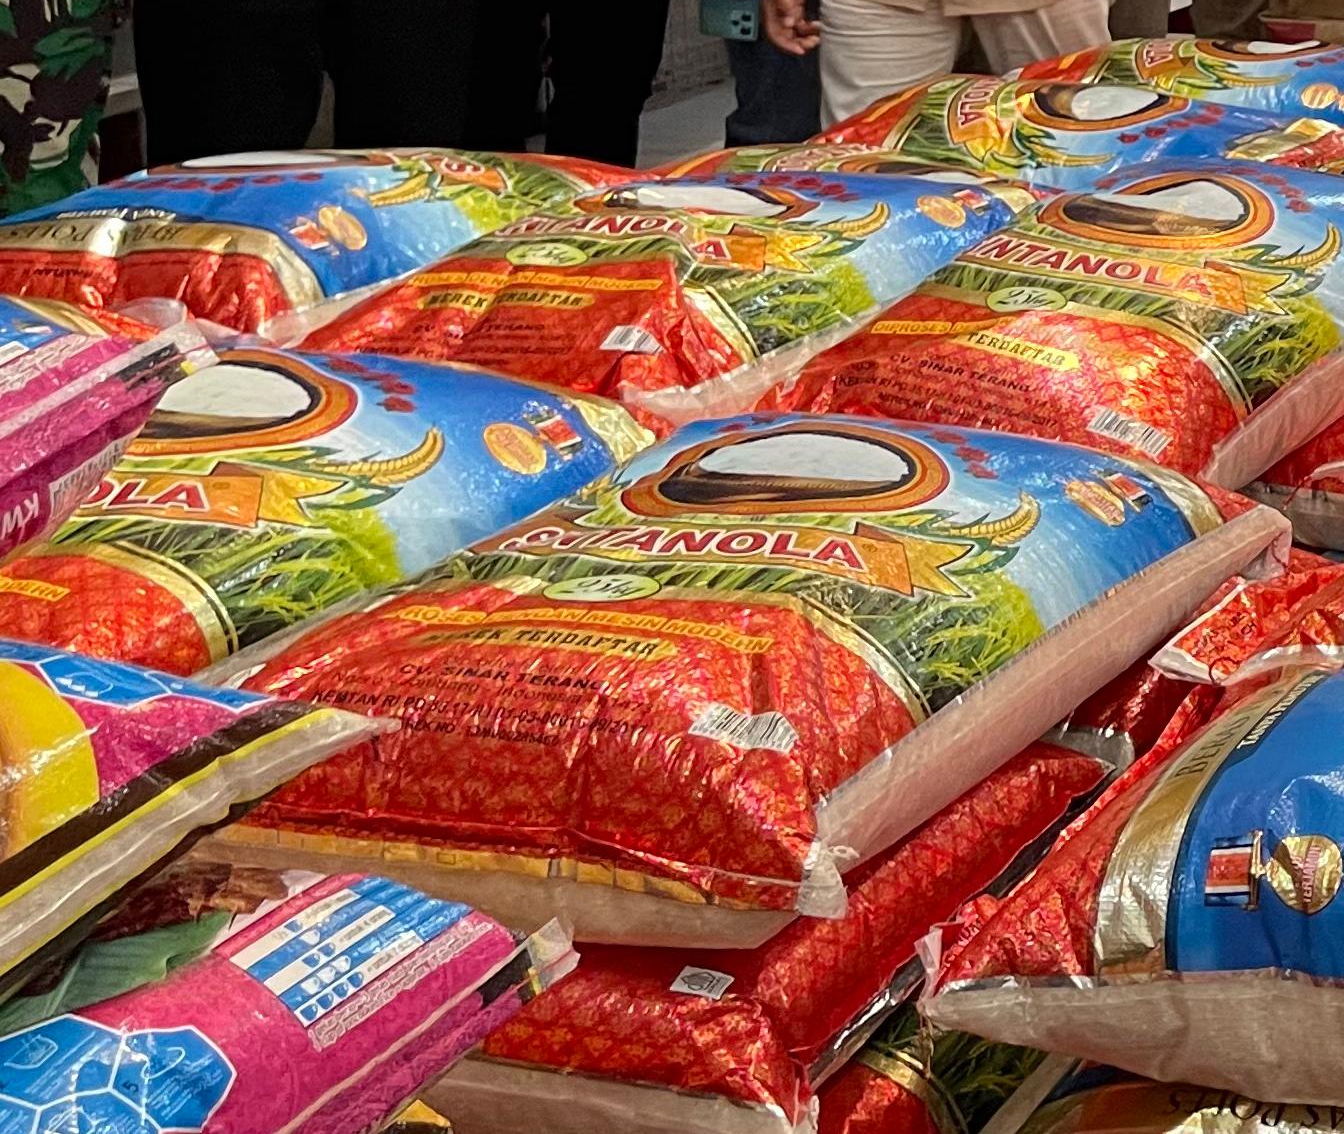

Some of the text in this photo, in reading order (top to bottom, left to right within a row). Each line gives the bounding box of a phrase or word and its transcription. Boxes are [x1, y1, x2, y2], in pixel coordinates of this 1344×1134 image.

[988, 235, 1214, 299] INTANOLA
[967, 331, 1067, 368] TERDAFTAR
[515, 629, 658, 656] TERDAFTAR
[665, 619, 771, 653] MODERN
[443, 665, 508, 682] SINAR
